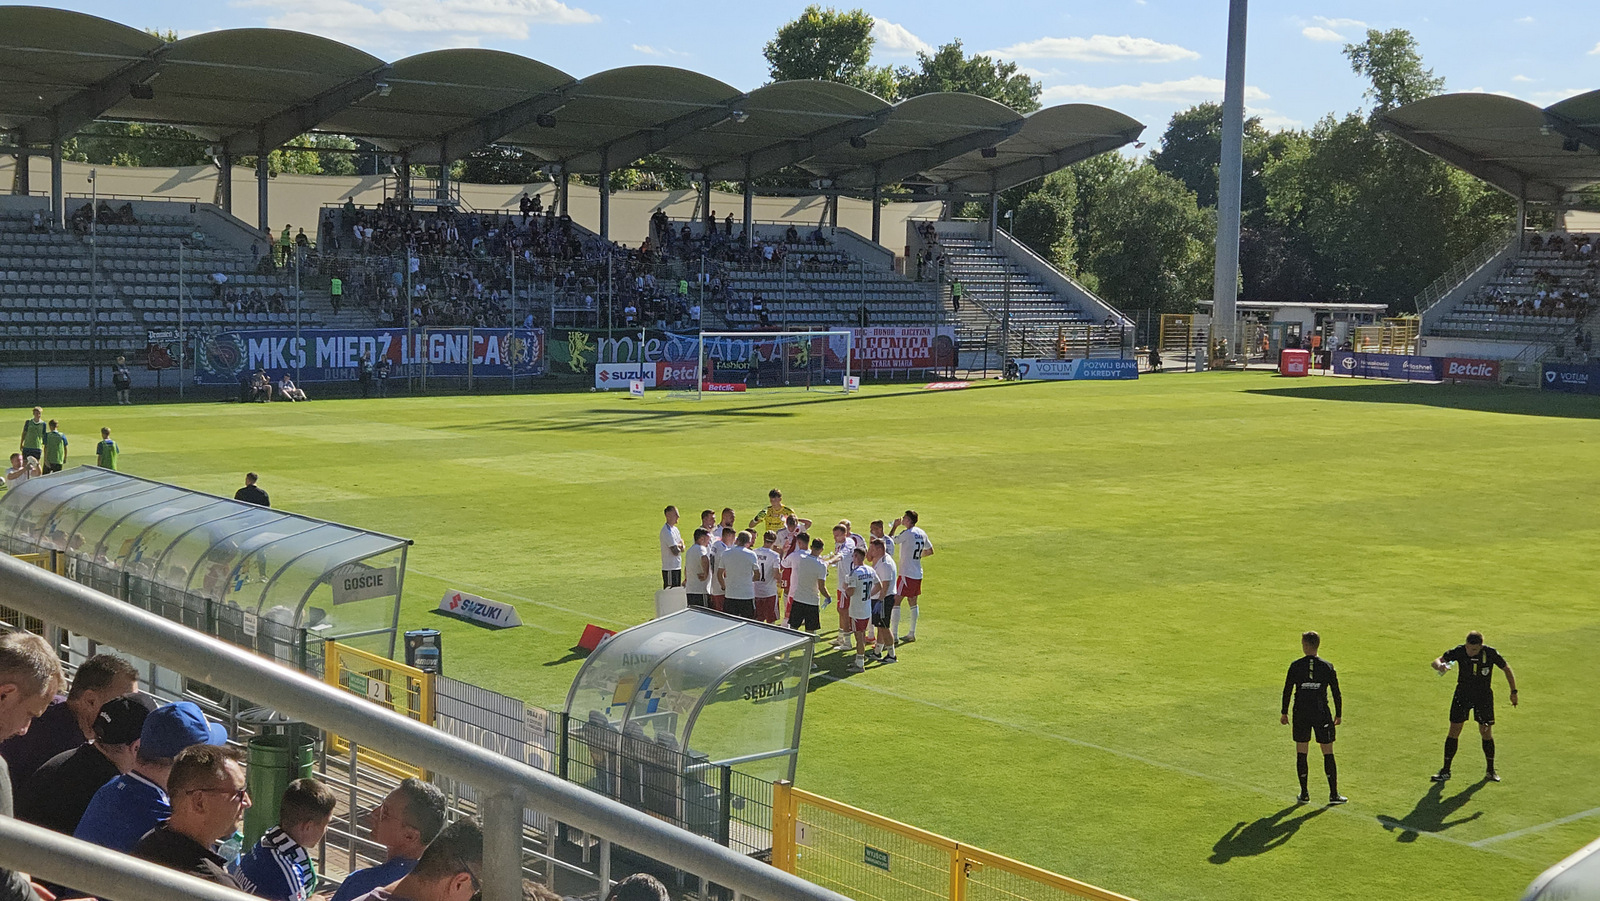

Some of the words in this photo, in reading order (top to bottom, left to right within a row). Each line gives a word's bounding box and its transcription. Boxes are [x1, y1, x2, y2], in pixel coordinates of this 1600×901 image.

[190, 204, 196, 214] B
[329, 209, 335, 218] C
[250, 337, 306, 370] MKS
[401, 334, 501, 365] LEGNICA
[853, 336, 931, 359] LEGNICA
[1035, 363, 1073, 372] VOTUM
[1449, 362, 1493, 377] Betclic
[612, 371, 654, 381] SUZUKI
[1561, 372, 1589, 381] VOTUM
[344, 574, 384, 591] GOŚCIE
[460, 599, 503, 621] SUZUKI
[373, 683, 380, 698] 2
[743, 680, 785, 703] SĘDZIA
[800, 827, 805, 840] 1
